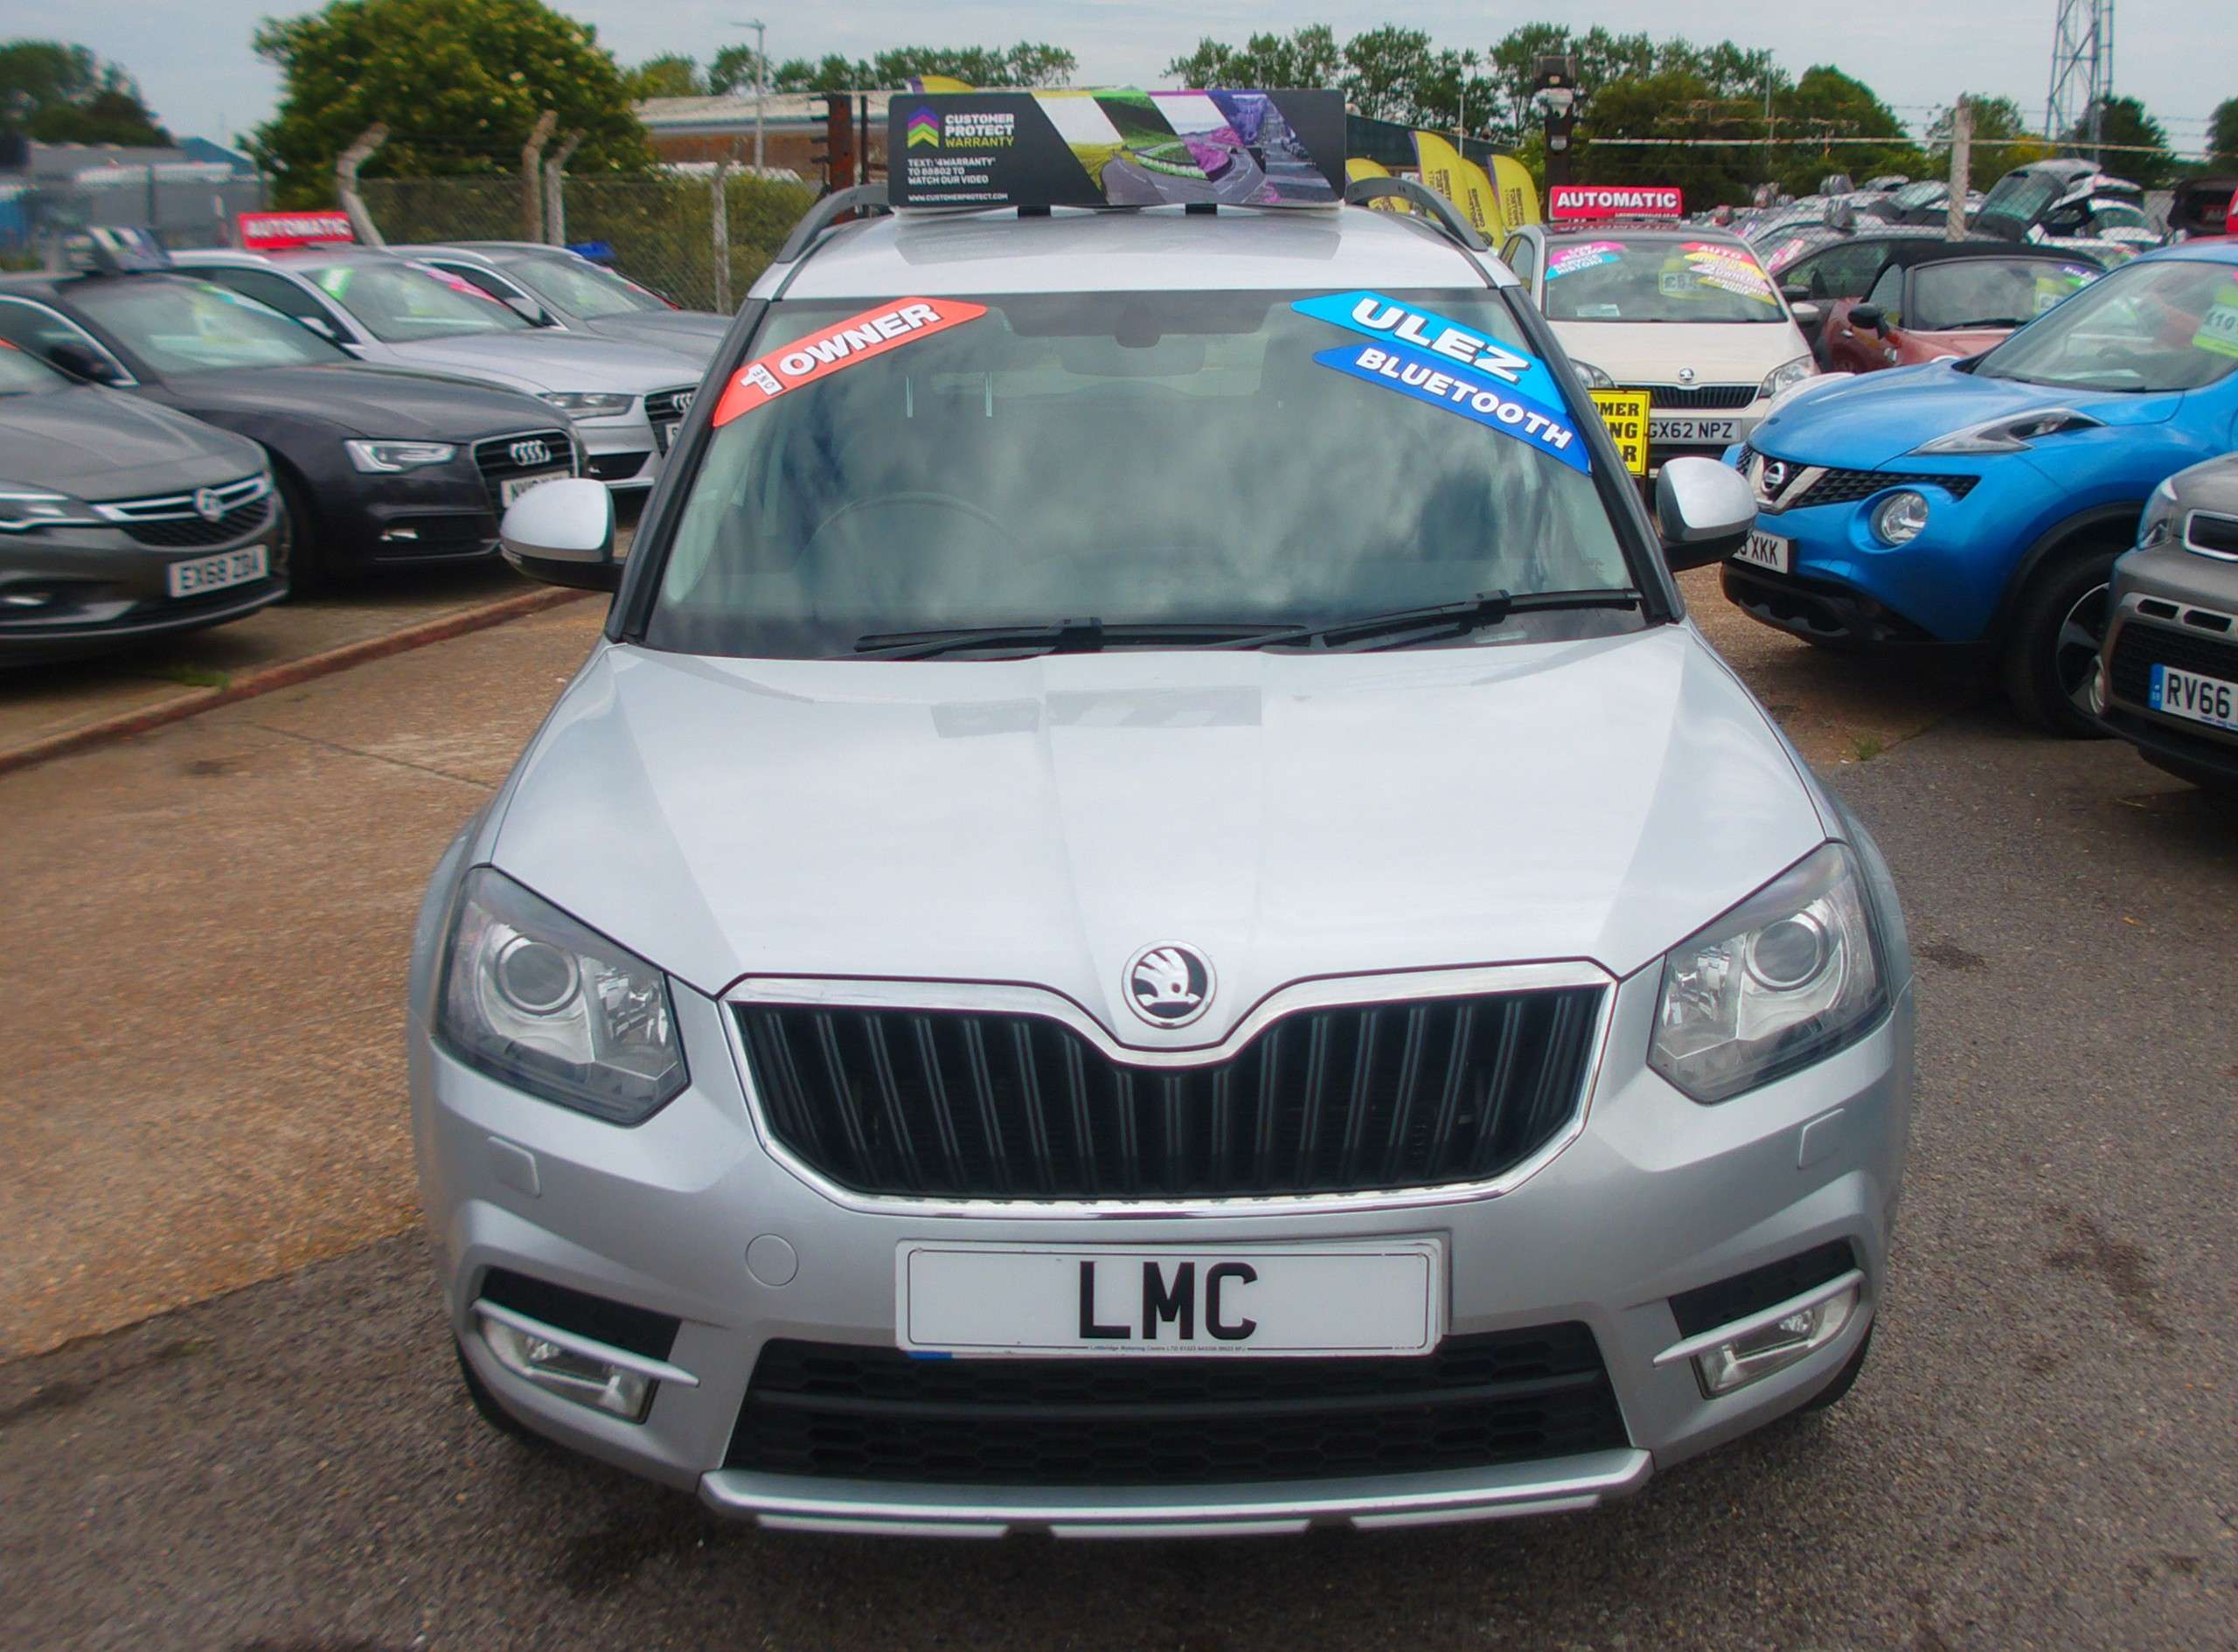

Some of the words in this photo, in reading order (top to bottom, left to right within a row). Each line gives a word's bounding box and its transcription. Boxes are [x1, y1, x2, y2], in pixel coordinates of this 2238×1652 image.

[945, 114, 1014, 124] CUSTOMER
[945, 124, 1014, 136] PROTECT
[945, 136, 1014, 148] WARRANTY
[908, 167, 921, 176] TO
[908, 176, 940, 184] WATCH
[941, 176, 960, 184] OUR
[961, 175, 989, 184] VIDEO
[1557, 191, 1678, 208] AUTOMATIC
[246, 218, 351, 238] AUTOMATIC
[1697, 244, 1742, 260] AUTO
[740, 364, 786, 395] 1
[779, 303, 943, 376] OWNER
[1352, 297, 1532, 385] ULEZ
[1355, 347, 1574, 450] BLUETOOTH
[1650, 421, 1693, 438] GX62
[1699, 421, 1734, 438] NPZ
[1750, 534, 1778, 566] XKK
[2166, 672, 2231, 718] RV66
[1079, 1260, 1259, 1341] LMC
